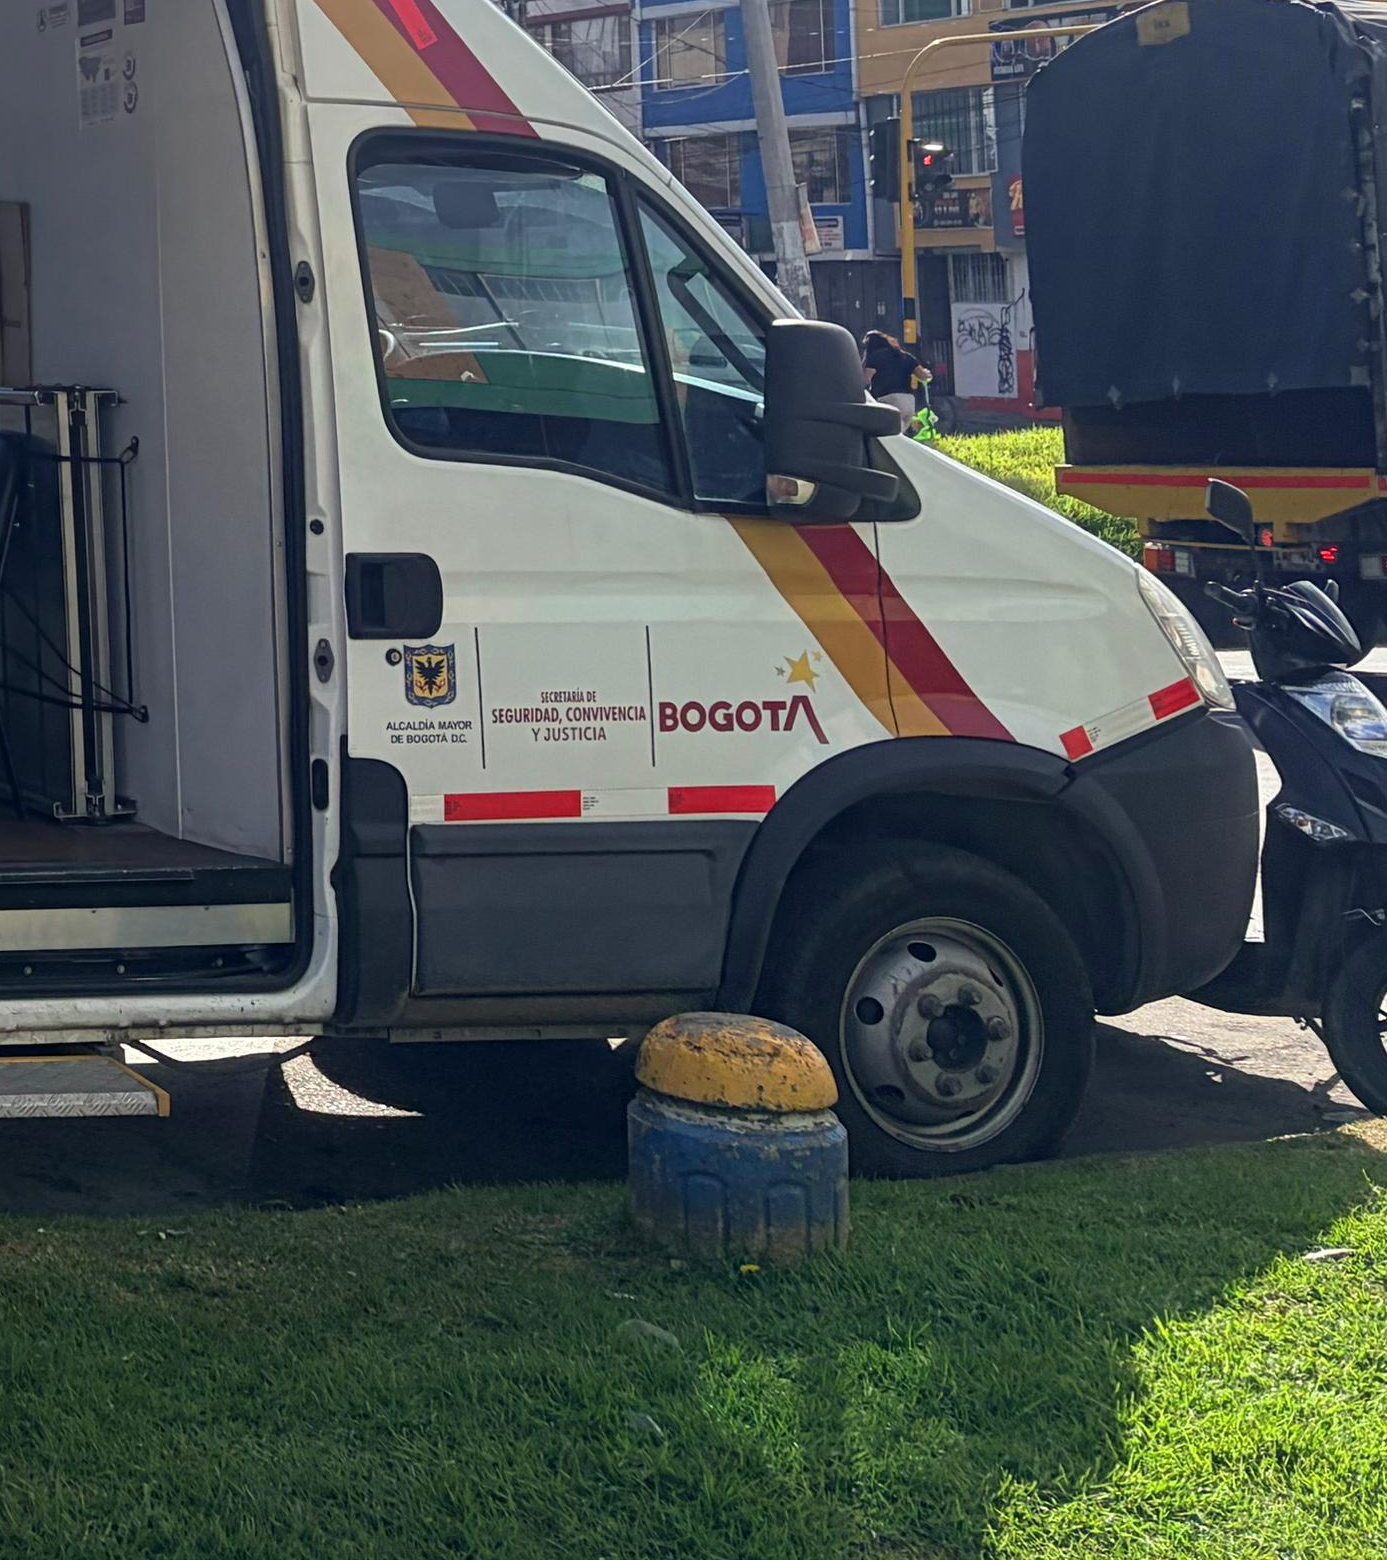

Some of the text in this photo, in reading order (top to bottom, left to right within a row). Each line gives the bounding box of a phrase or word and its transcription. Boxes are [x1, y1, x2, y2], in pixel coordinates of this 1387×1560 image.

[540, 688, 597, 703] SECRETARÍA DE
[492, 704, 647, 726] SEGURIDAD, CONVIVENCIA
[386, 718, 472, 730] ALCALDÍA MAYOR
[390, 734, 404, 744] DE
[406, 732, 448, 744] BOGOTÁ
[532, 726, 607, 742] Y JUSTICIA
